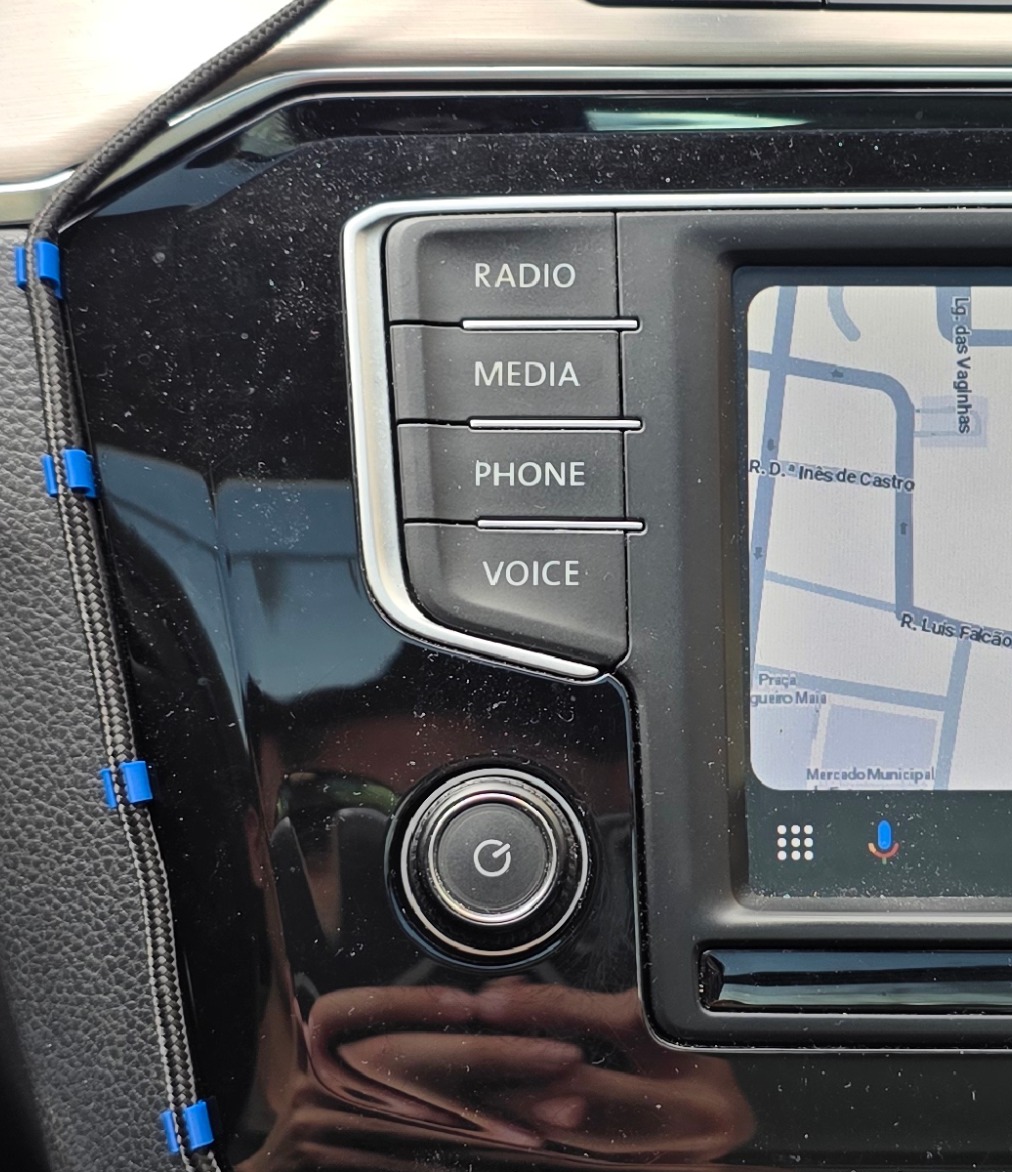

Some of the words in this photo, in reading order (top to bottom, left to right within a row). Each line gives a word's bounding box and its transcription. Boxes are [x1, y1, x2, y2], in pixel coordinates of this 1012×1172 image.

[475, 263, 576, 288] RADIO
[950, 297, 969, 321] Lg.
[955, 327, 970, 354] das
[475, 361, 580, 387] MEDIA
[953, 356, 972, 434] Vaginhas
[475, 461, 585, 487] PHONE
[749, 459, 765, 475] R.
[799, 465, 833, 483] Inês
[837, 468, 857, 484] de
[860, 472, 915, 492] Castro
[482, 560, 579, 586] VOICE
[901, 614, 917, 631] R.
[959, 626, 1012, 648] Falcão
[758, 674, 797, 689] Praça
[796, 691, 827, 704] Maia
[806, 768, 866, 781] Mercado
[867, 767, 935, 783] Municipal
